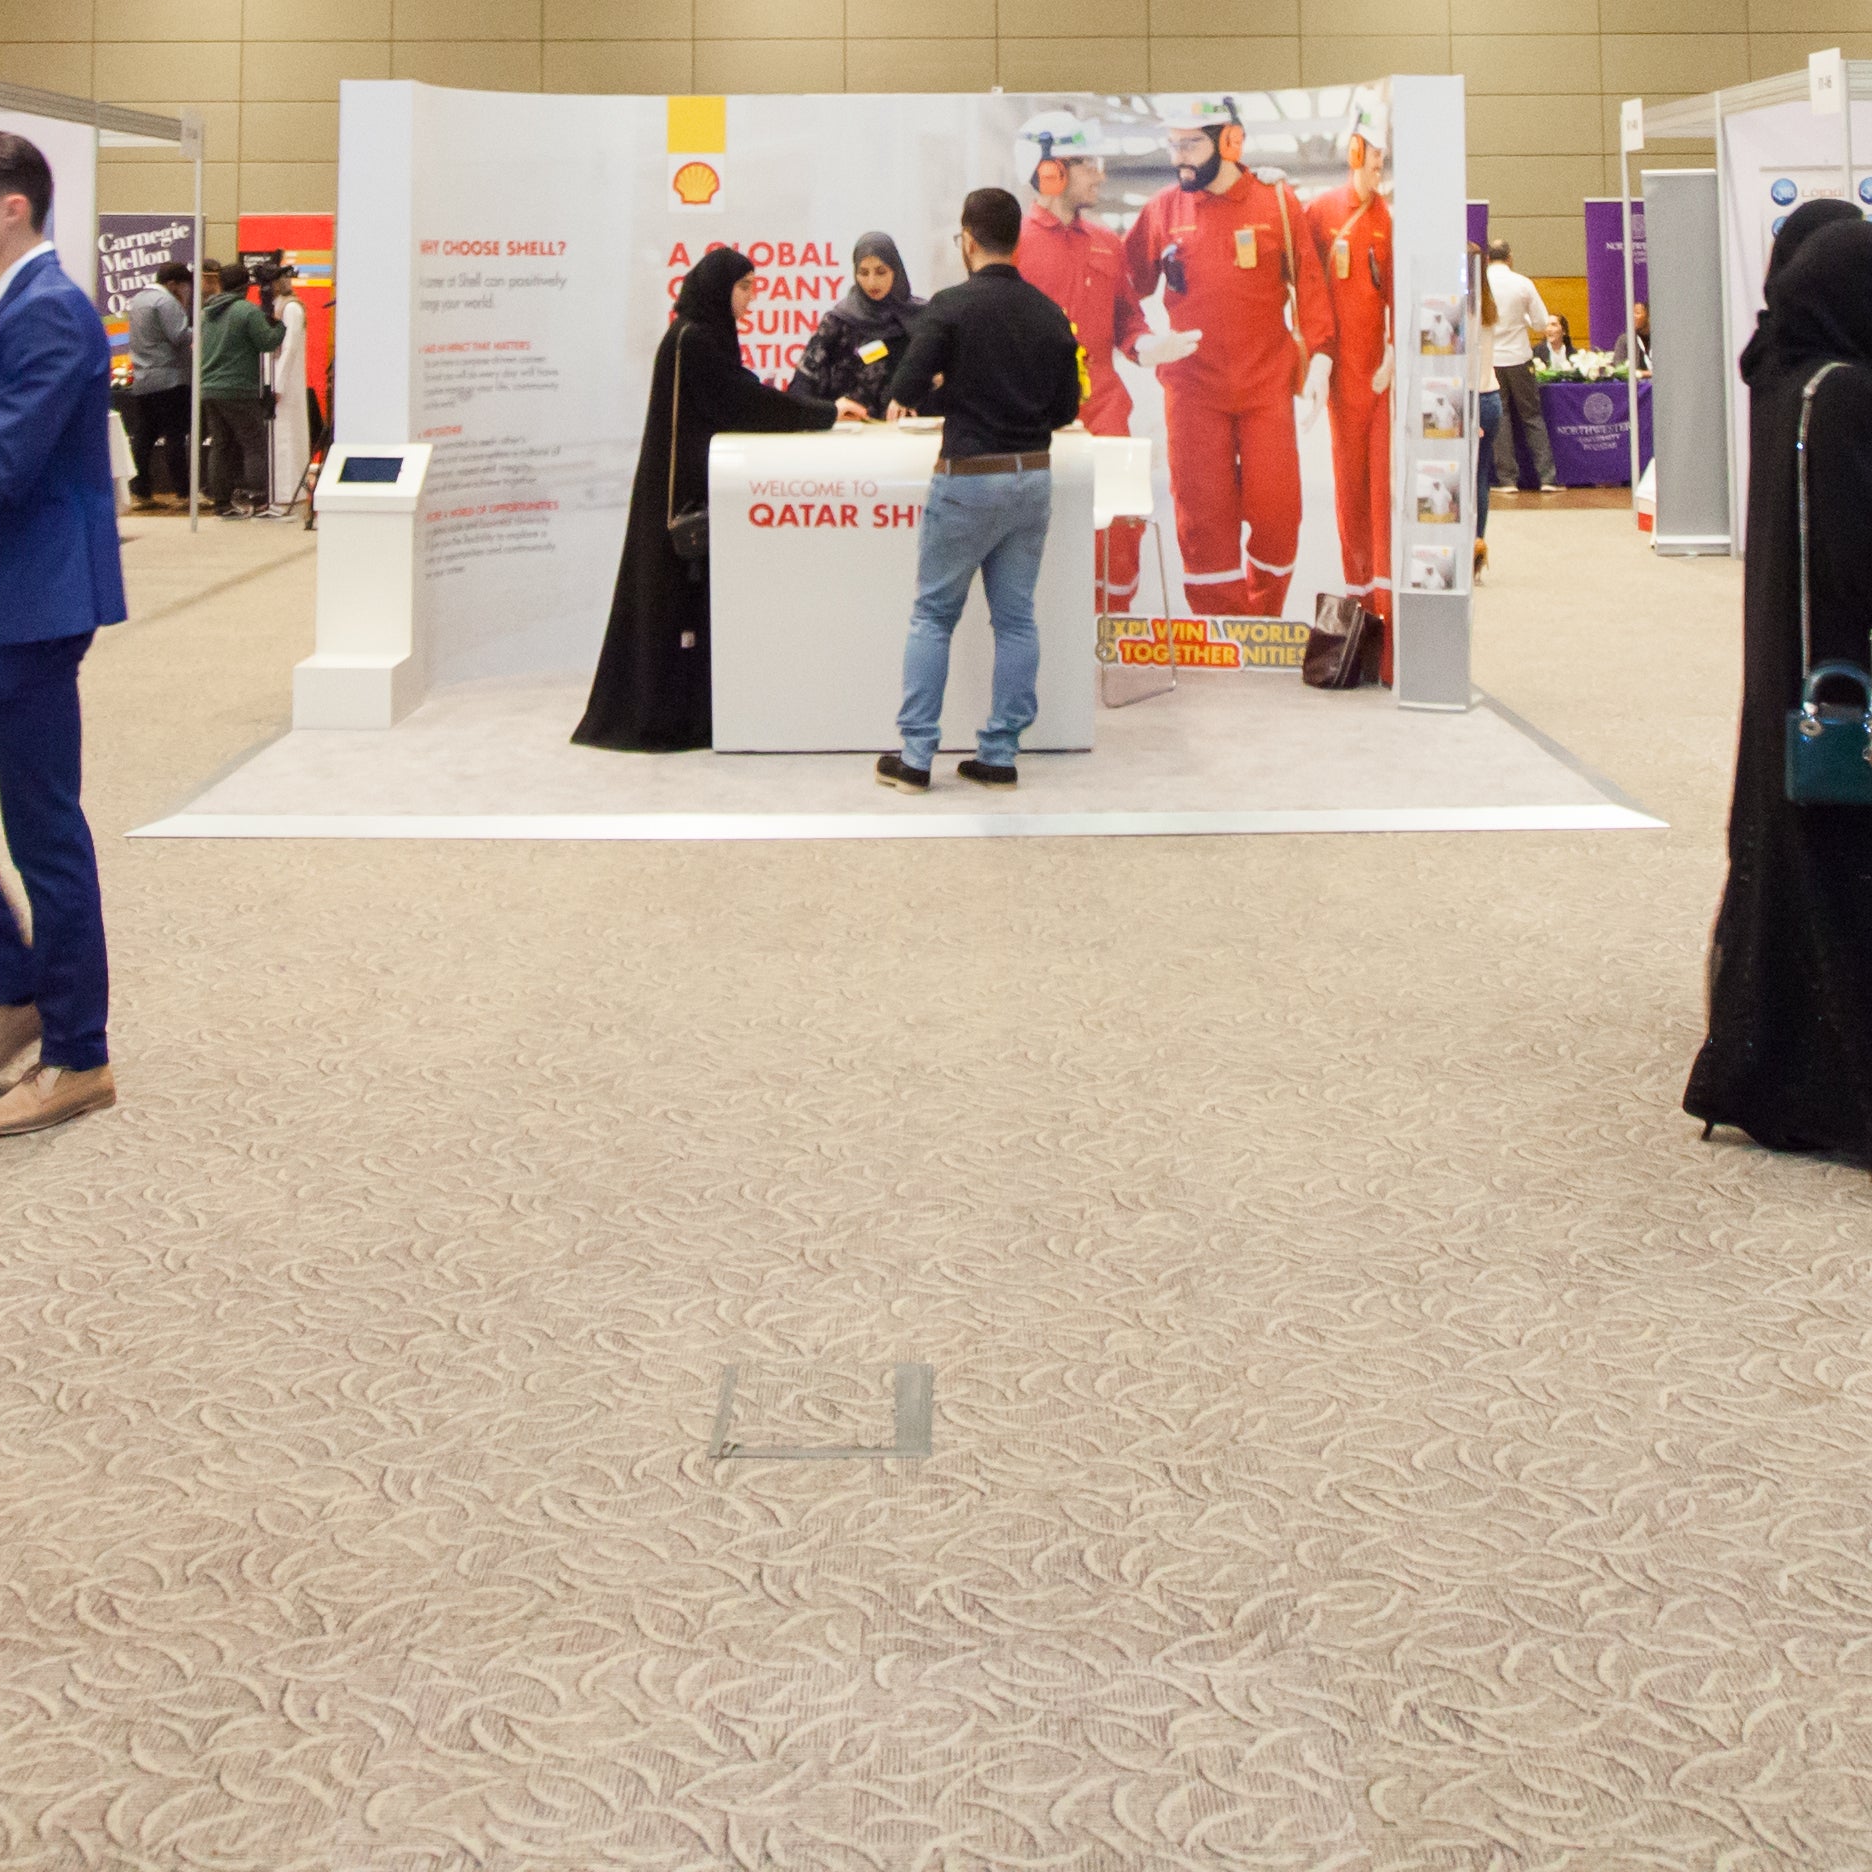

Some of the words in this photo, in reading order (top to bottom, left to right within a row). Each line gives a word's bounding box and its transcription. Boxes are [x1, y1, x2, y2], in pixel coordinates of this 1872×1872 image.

[98, 221, 190, 254] Carnegie
[443, 240, 500, 257] CHOOSE
[506, 240, 567, 257] SHELL?
[100, 248, 172, 274] Mellon
[667, 242, 691, 267] A
[705, 242, 839, 267] OBAL
[749, 480, 846, 497] WELCOME
[853, 480, 879, 497] TO
[748, 503, 859, 528] QATAR
[1154, 622, 1205, 641] WIN
[1225, 624, 1310, 644] WORLD
[1121, 642, 1237, 666] TOGETHER
